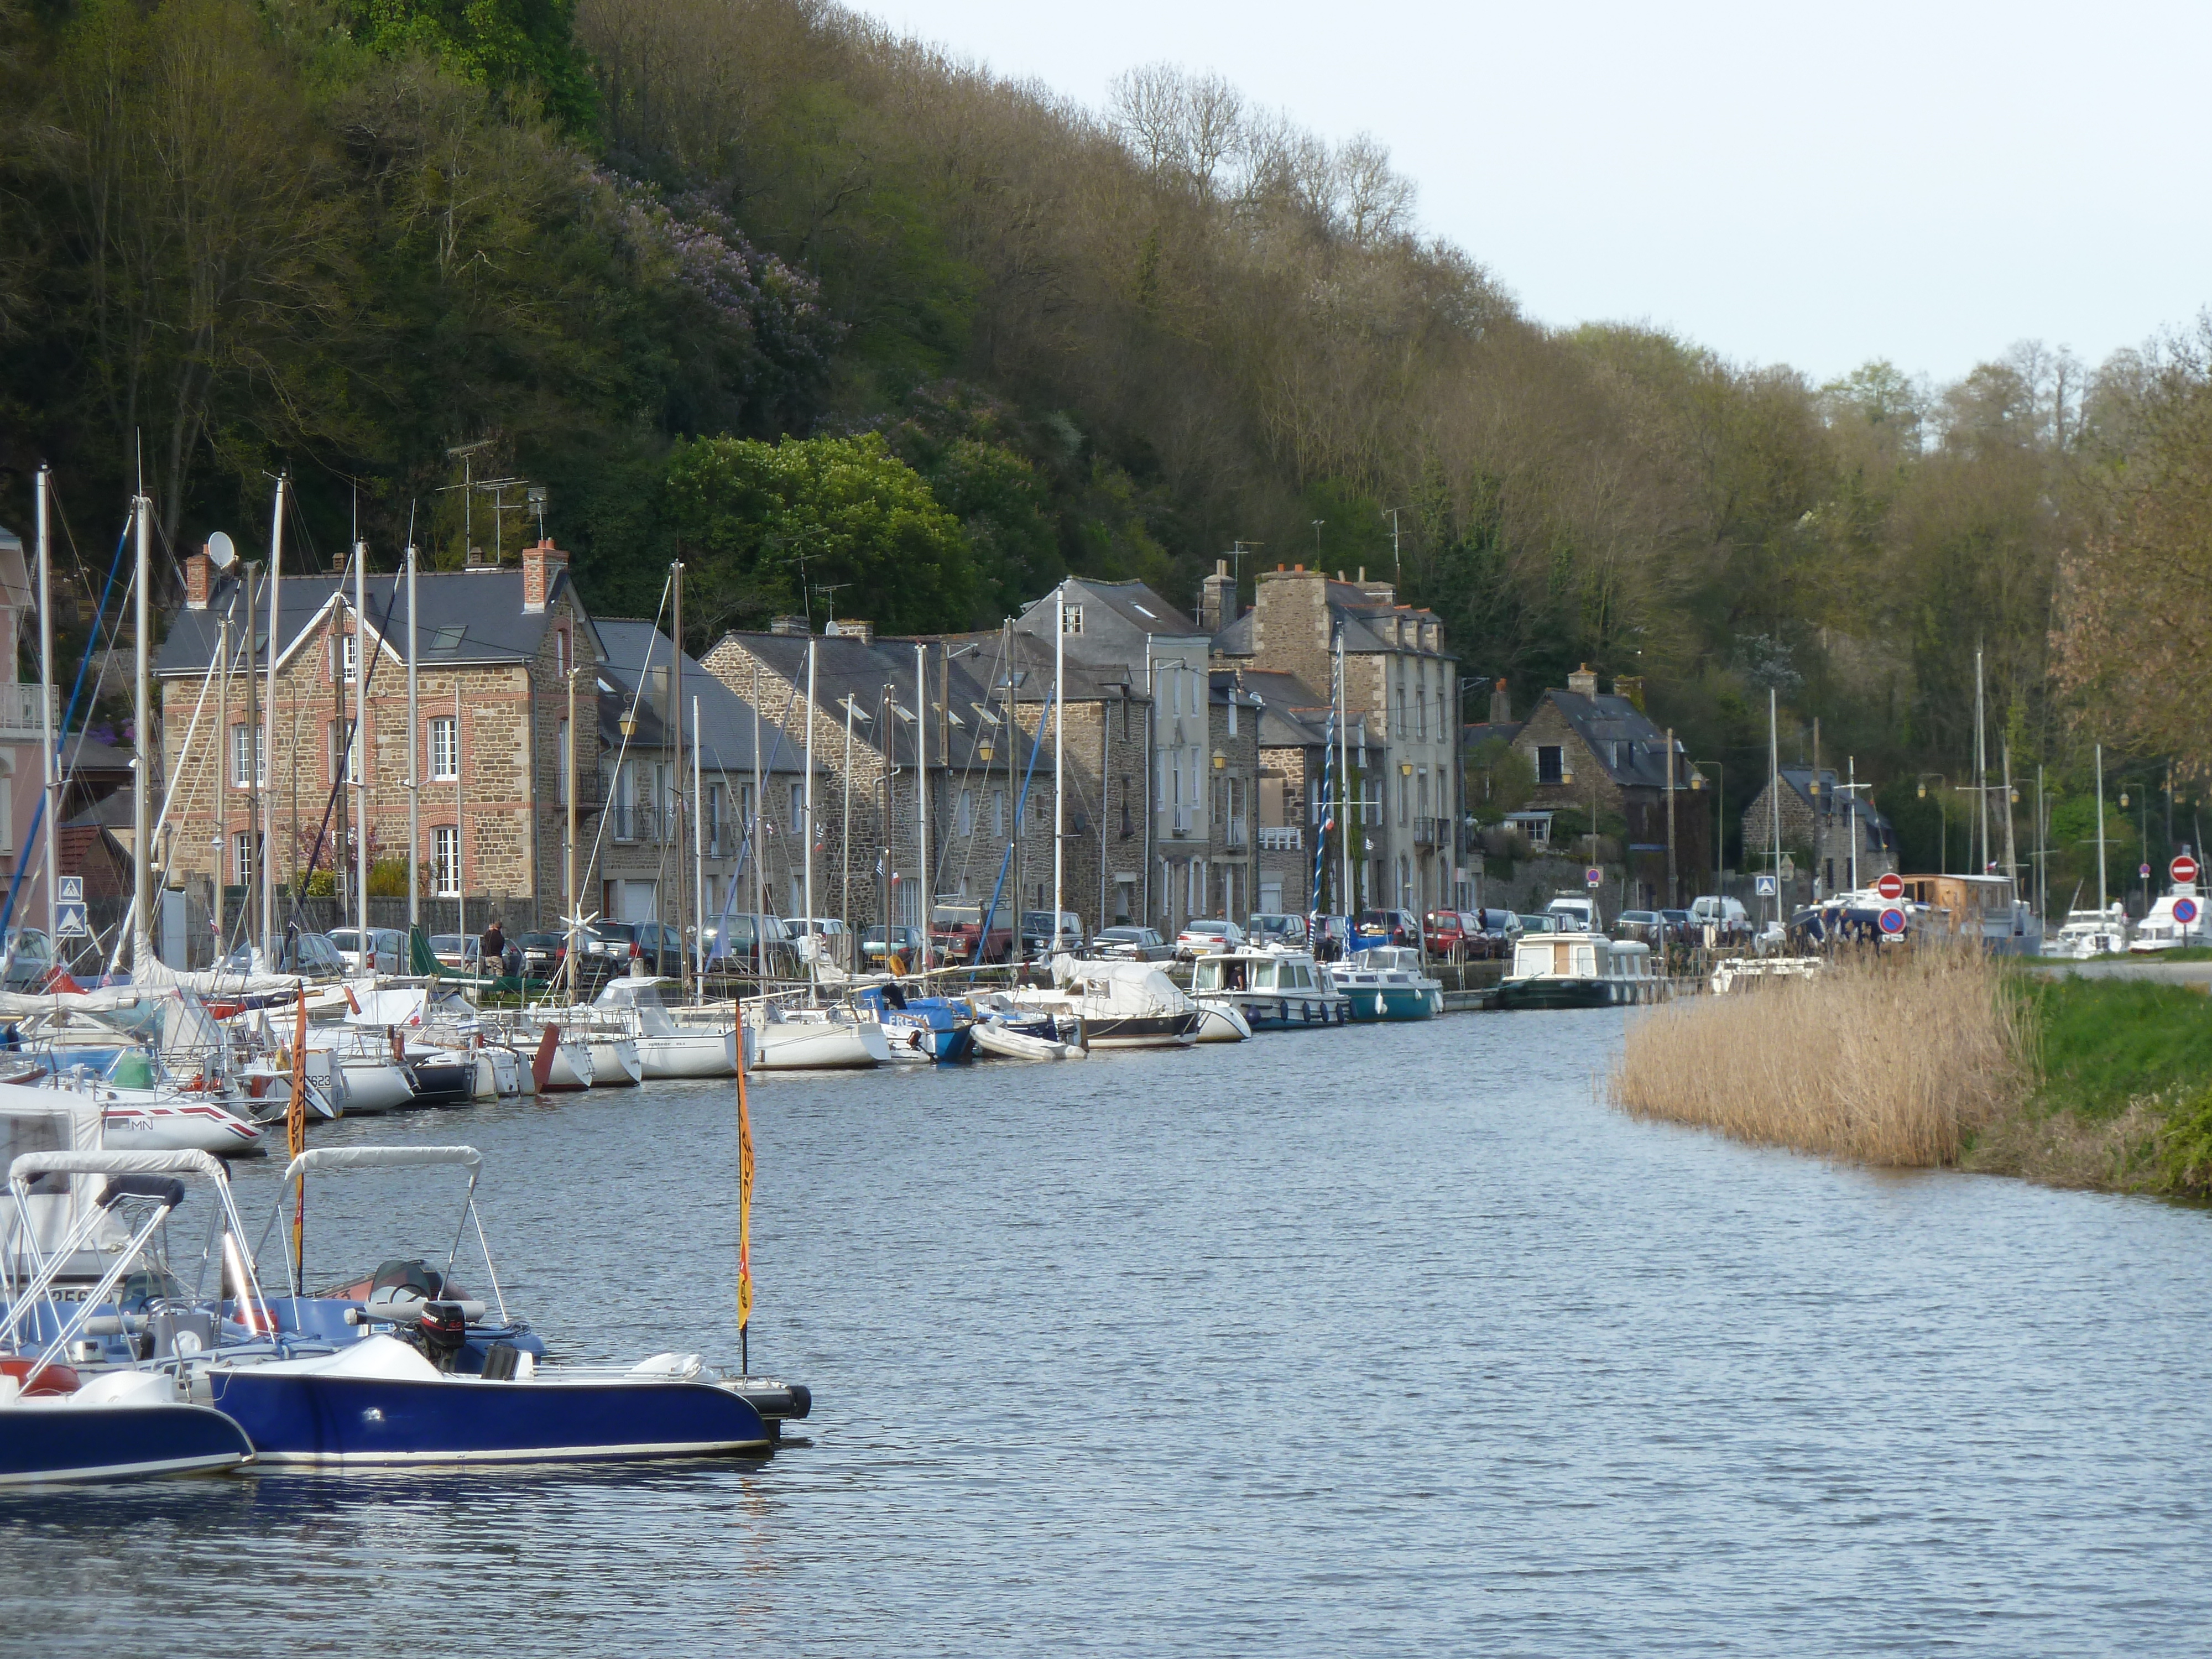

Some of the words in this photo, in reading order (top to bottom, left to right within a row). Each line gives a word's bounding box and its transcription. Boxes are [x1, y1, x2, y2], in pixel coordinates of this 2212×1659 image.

[889, 1014, 930, 1027] FREYA
[306, 1075, 331, 1086] 623
[132, 1120, 153, 1131] MN
